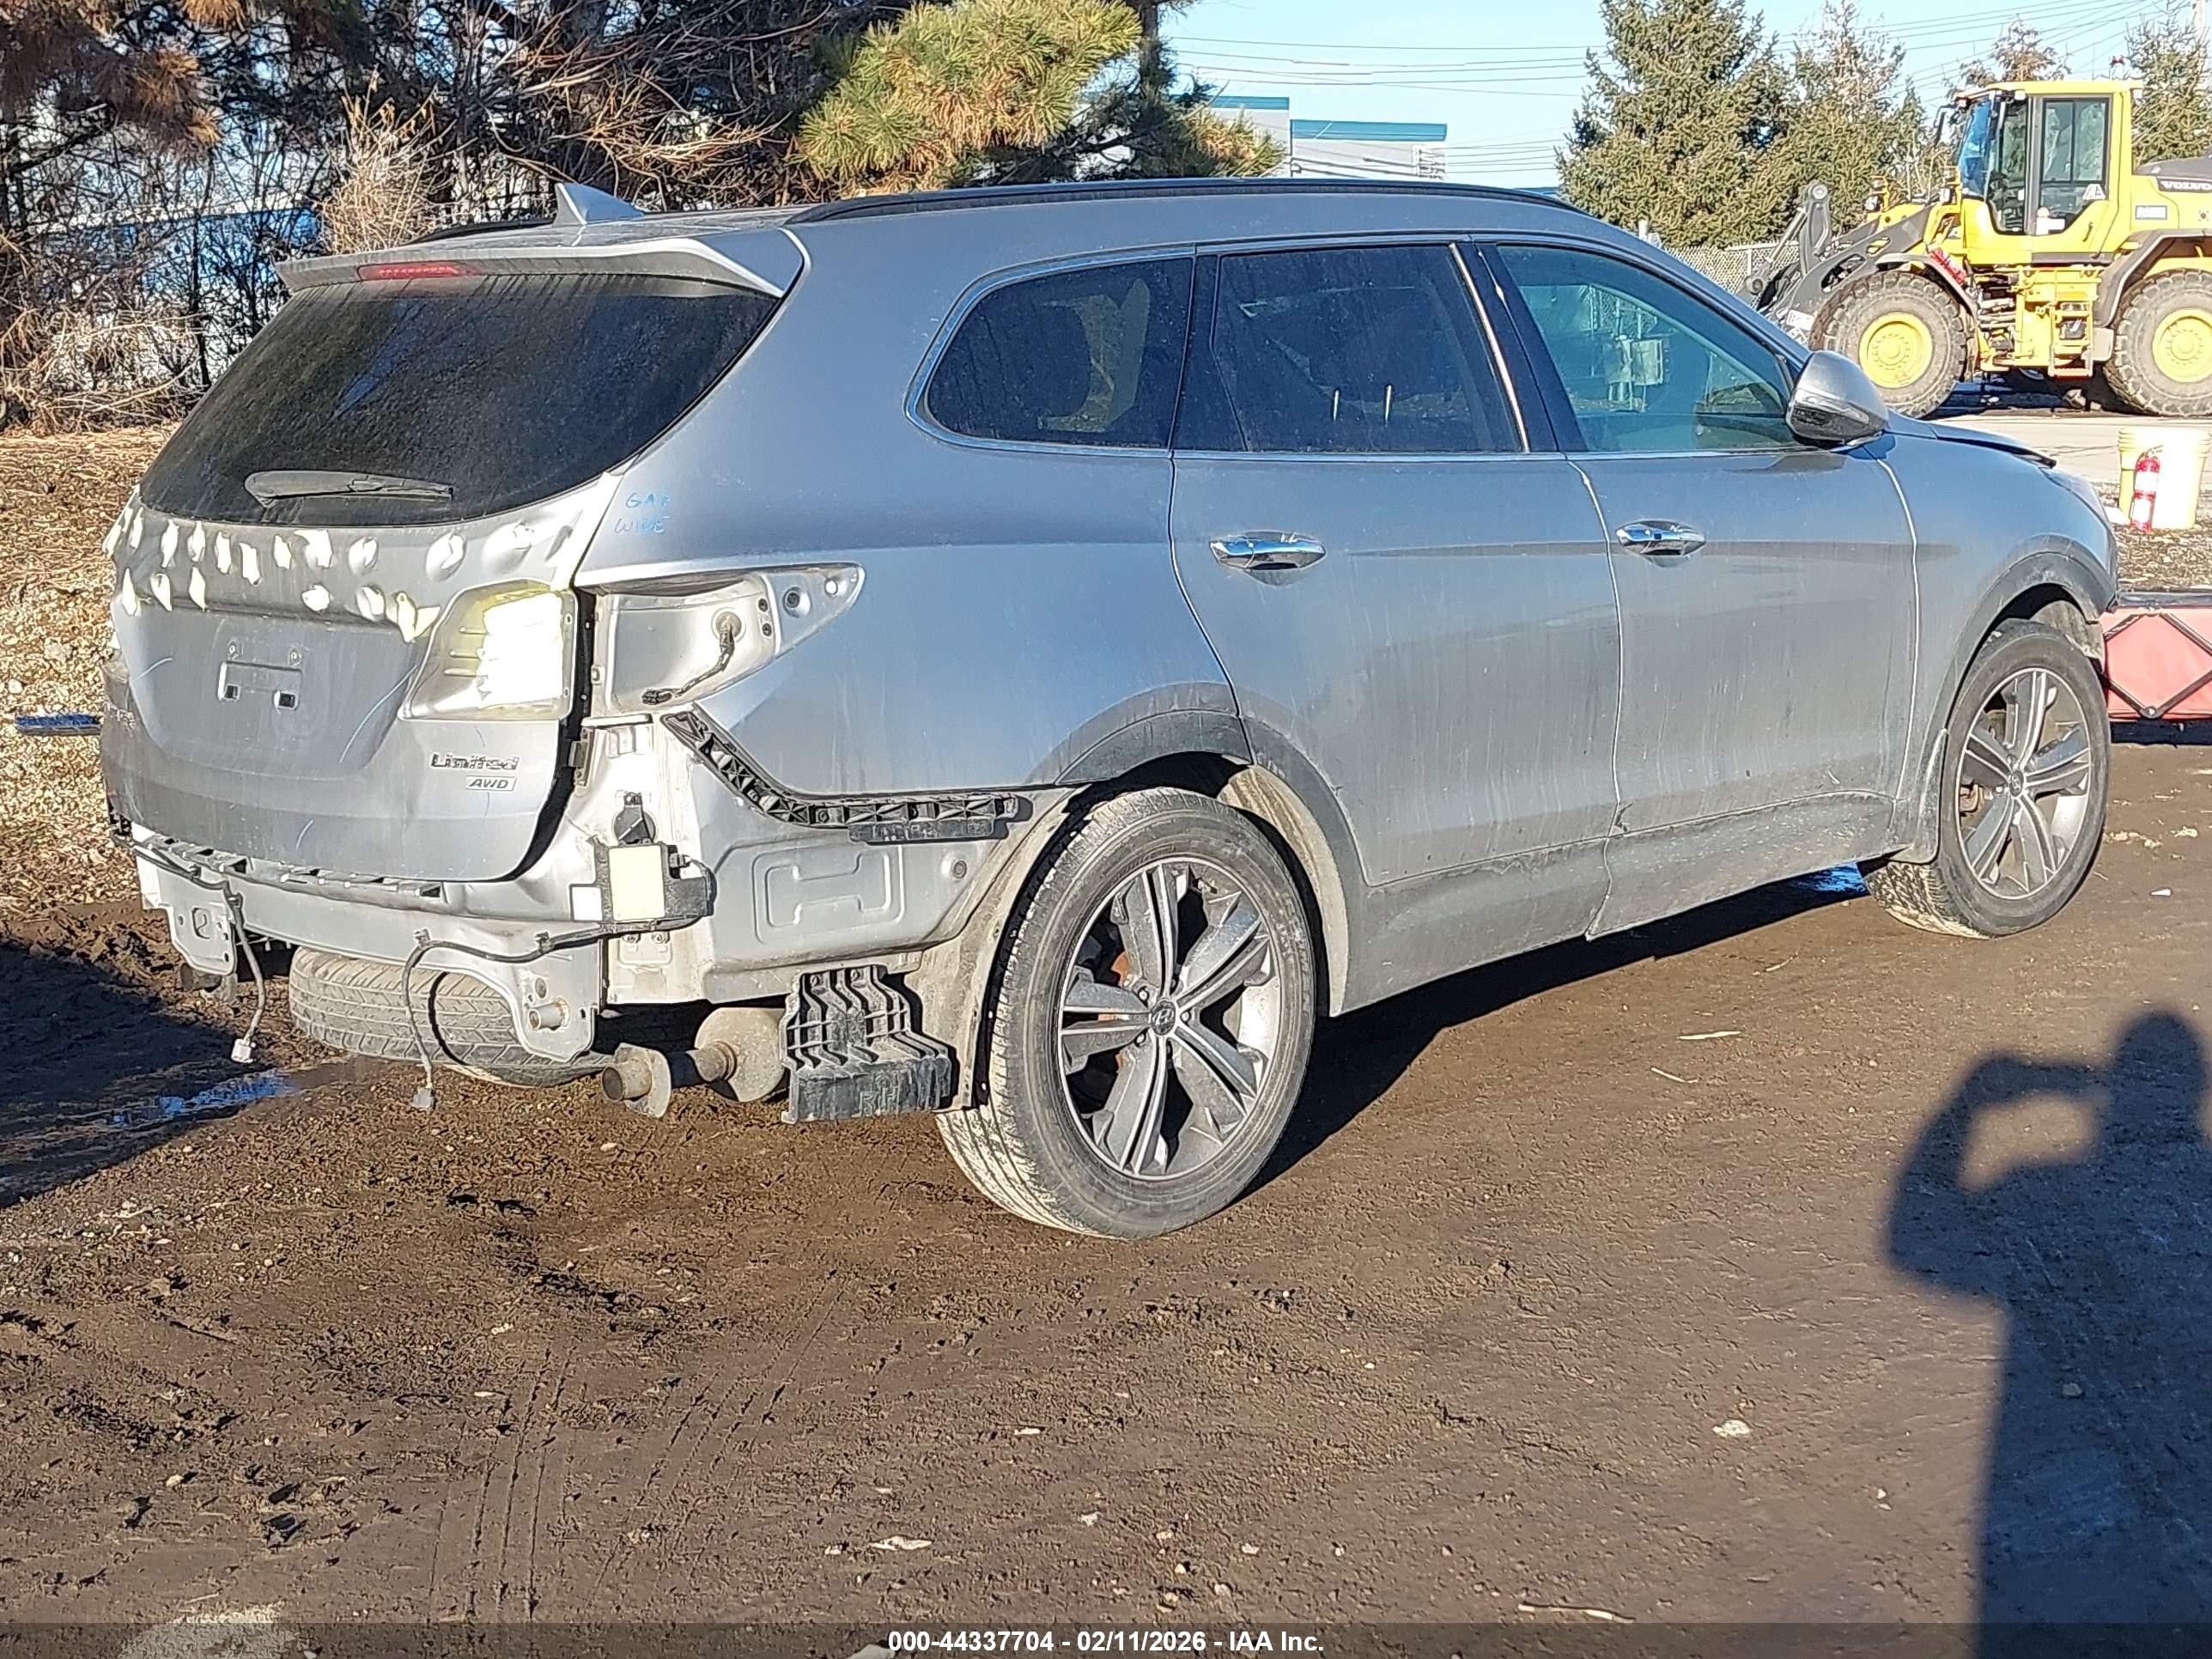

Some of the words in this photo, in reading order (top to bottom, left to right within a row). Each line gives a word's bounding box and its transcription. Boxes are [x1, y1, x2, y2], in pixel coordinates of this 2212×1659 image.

[2159, 180, 2212, 191] VOLVO
[430, 752, 520, 770] Limited
[468, 778, 509, 789] AWD
